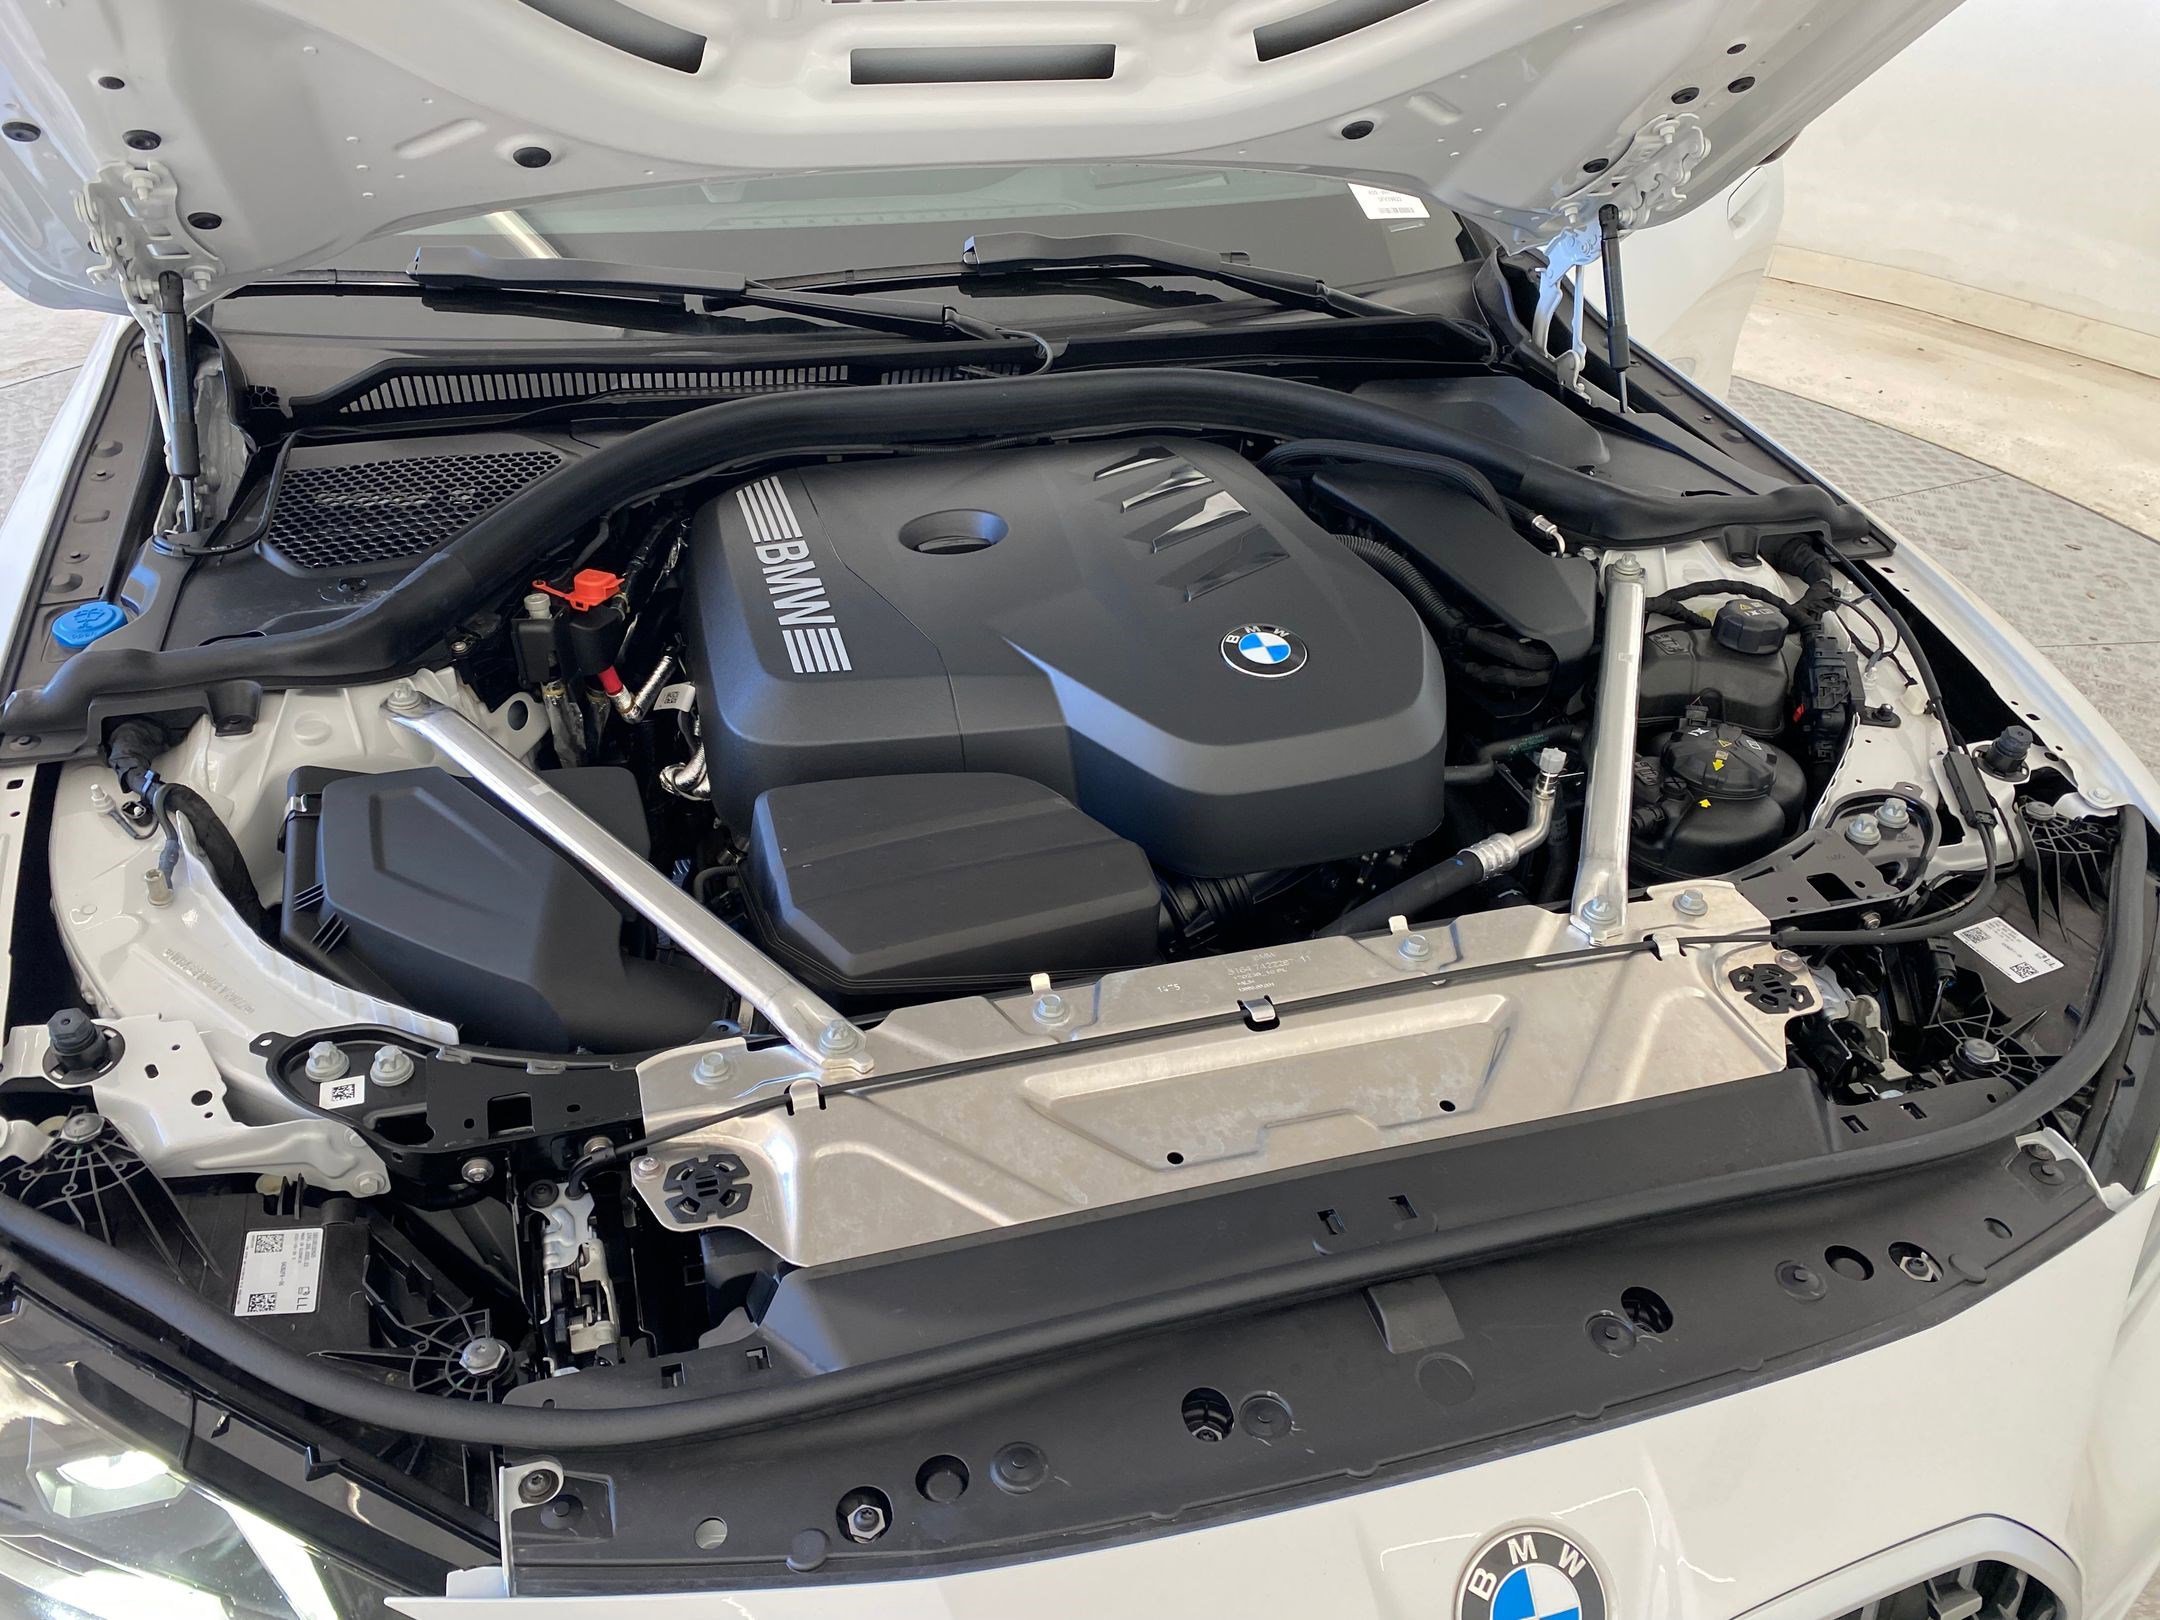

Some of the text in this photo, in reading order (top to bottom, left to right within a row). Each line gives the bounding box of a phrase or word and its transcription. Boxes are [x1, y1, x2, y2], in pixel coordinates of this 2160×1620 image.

[755, 540, 836, 626] BMW
[1225, 625, 1290, 644] BMW
[296, 1297, 309, 1311] LL
[1467, 1534, 1587, 1601] BMW
